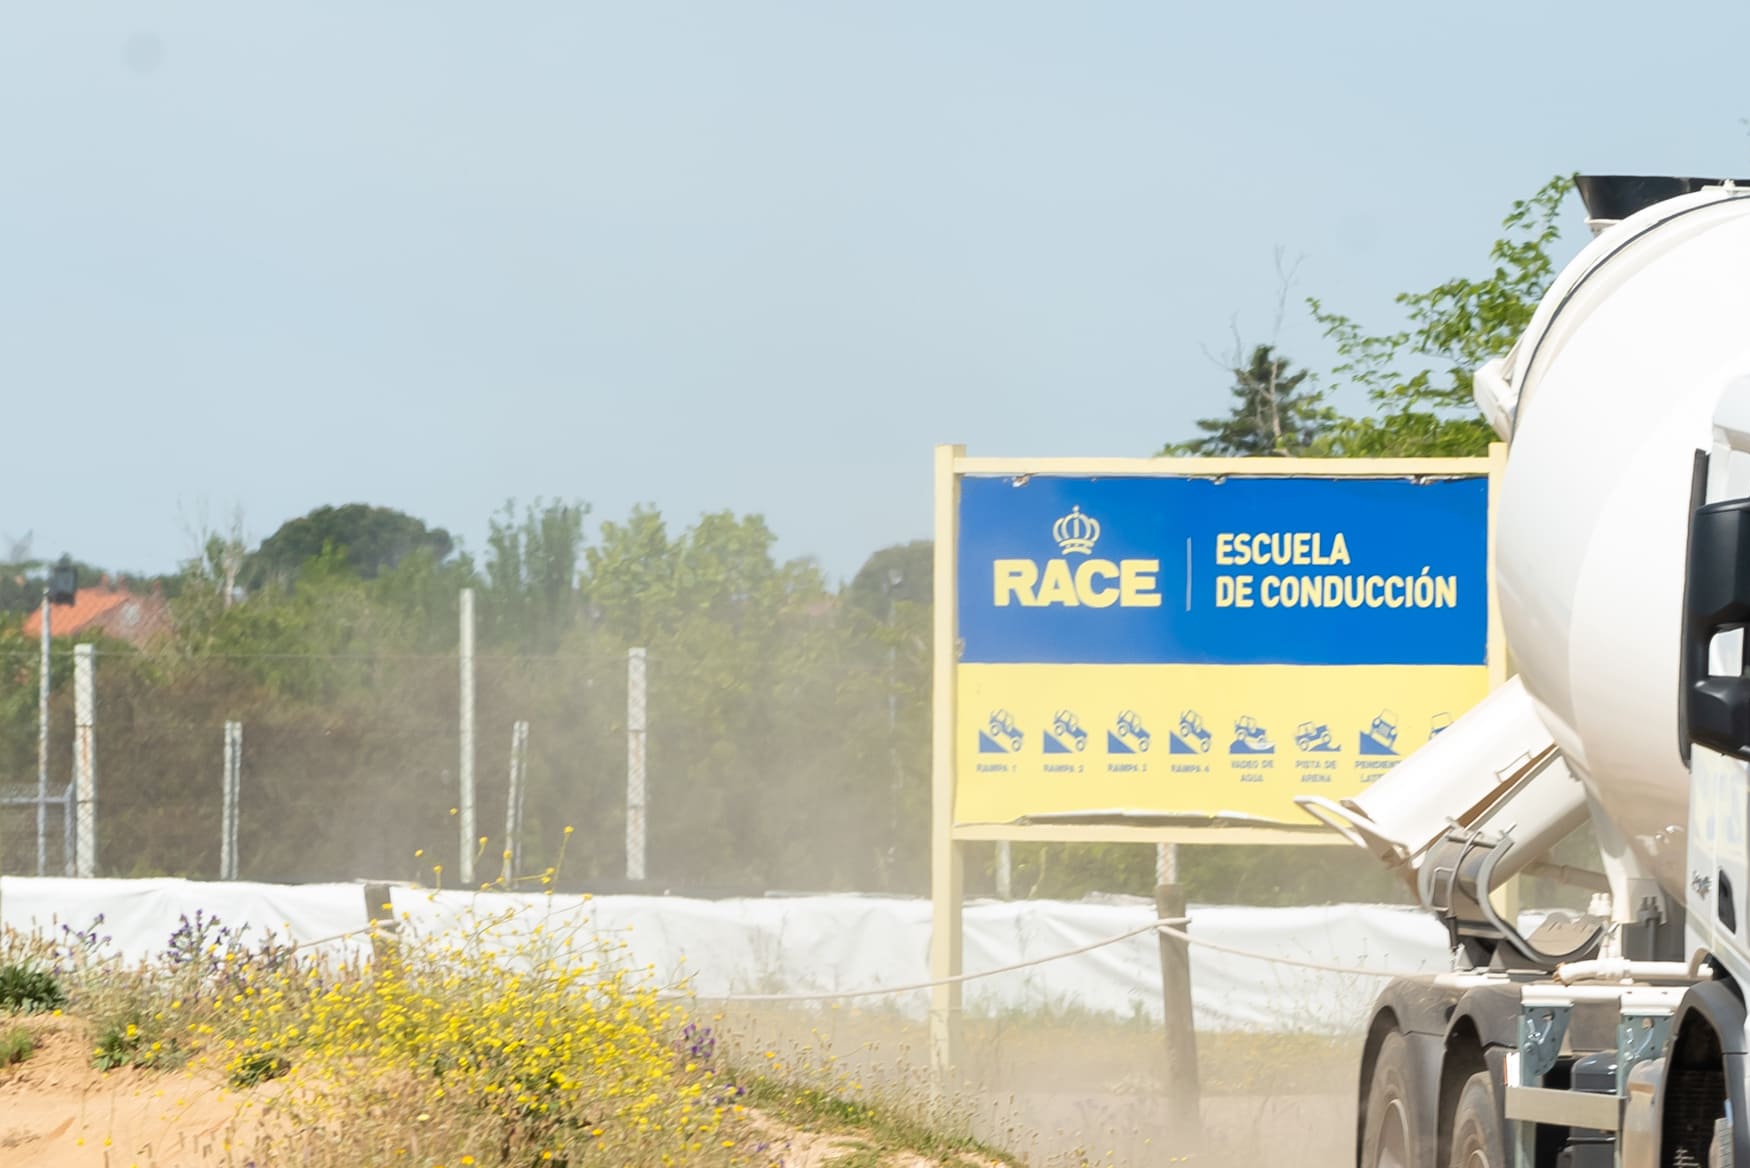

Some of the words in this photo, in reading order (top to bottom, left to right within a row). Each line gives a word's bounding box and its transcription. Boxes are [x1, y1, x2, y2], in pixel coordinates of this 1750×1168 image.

[1216, 532, 1351, 566] ESCUELA
[993, 558, 1162, 609] RACE
[1216, 575, 1255, 608] DE
[1260, 565, 1457, 609] CONDUCCIÓN
[976, 763, 1008, 772] RAMPA
[1043, 763, 1075, 773] RAMPA
[1107, 763, 1138, 772] RAMPA
[1170, 763, 1201, 773] RAMPA
